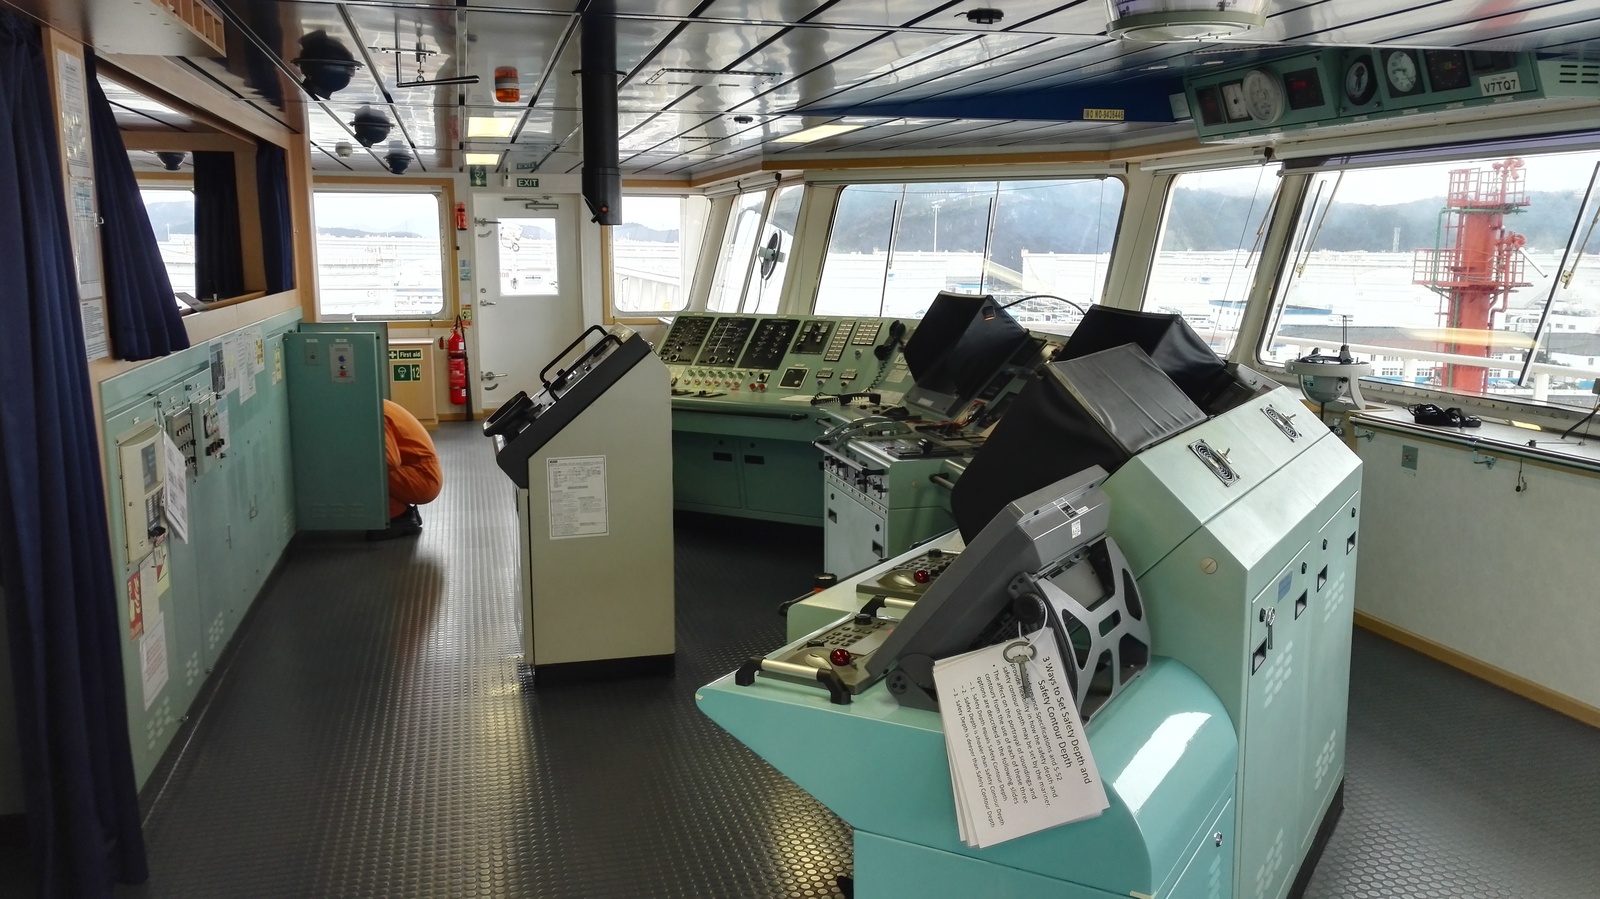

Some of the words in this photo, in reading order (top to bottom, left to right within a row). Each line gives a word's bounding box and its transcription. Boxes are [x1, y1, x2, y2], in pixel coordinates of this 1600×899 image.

[1484, 80, 1516, 93] V7TQ7
[412, 367, 420, 378] 12
[1002, 666, 1011, 683] safety
[1008, 684, 1019, 707] contour
[1015, 708, 1025, 726] depth
[1025, 740, 1032, 749] be
[1032, 759, 1038, 768] by
[1009, 663, 1021, 685] provide
[984, 673, 996, 698] contours
[1006, 744, 1015, 759] each
[1013, 768, 1022, 785] these
[1019, 786, 1028, 803] three
[996, 682, 1005, 699] affect
[1001, 699, 1008, 708] on
[1006, 719, 1021, 746] portrayal
[1018, 755, 1032, 786] soundings
[1028, 787, 1038, 799] and
[1037, 679, 1050, 704] Safety
[1046, 706, 1062, 739] Contour
[1058, 741, 1072, 768] Depth
[1045, 662, 1057, 685] Ways
[1052, 686, 1060, 696] to
[1056, 696, 1066, 711] Set
[1061, 711, 1075, 737] Safety
[1070, 738, 1085, 766] Depth
[1080, 767, 1092, 784] and
